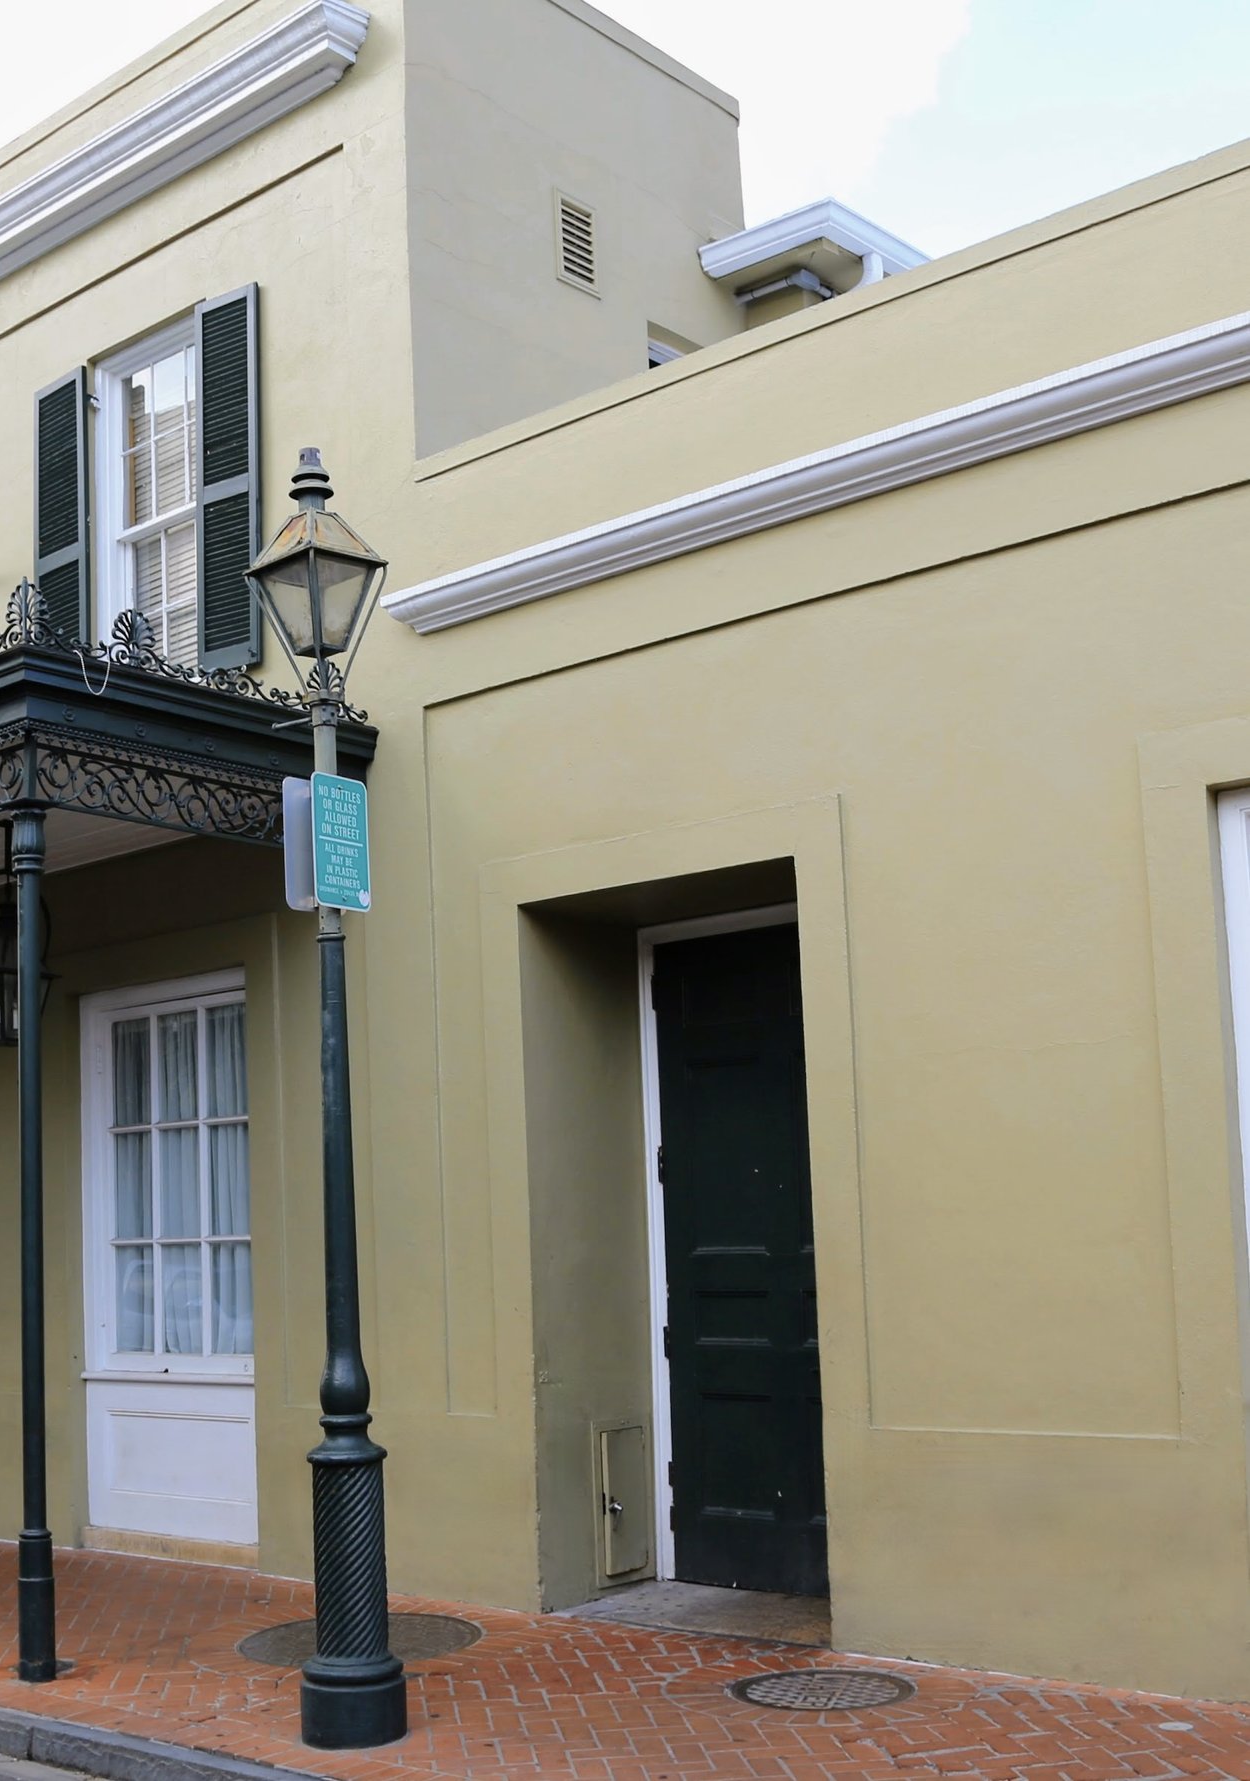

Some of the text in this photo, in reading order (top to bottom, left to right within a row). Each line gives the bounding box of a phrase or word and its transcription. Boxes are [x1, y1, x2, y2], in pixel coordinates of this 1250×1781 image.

[318, 784, 360, 804] NO BOTTLES
[322, 798, 357, 816] OR GLASS
[324, 811, 357, 827] ALLOWED
[321, 823, 360, 840] ON STREET
[324, 843, 358, 858] ALL DRINKS
[331, 854, 353, 867] MAY BE
[326, 864, 358, 879] IN PLASTIC
[324, 875, 361, 889] CONTAINERS
